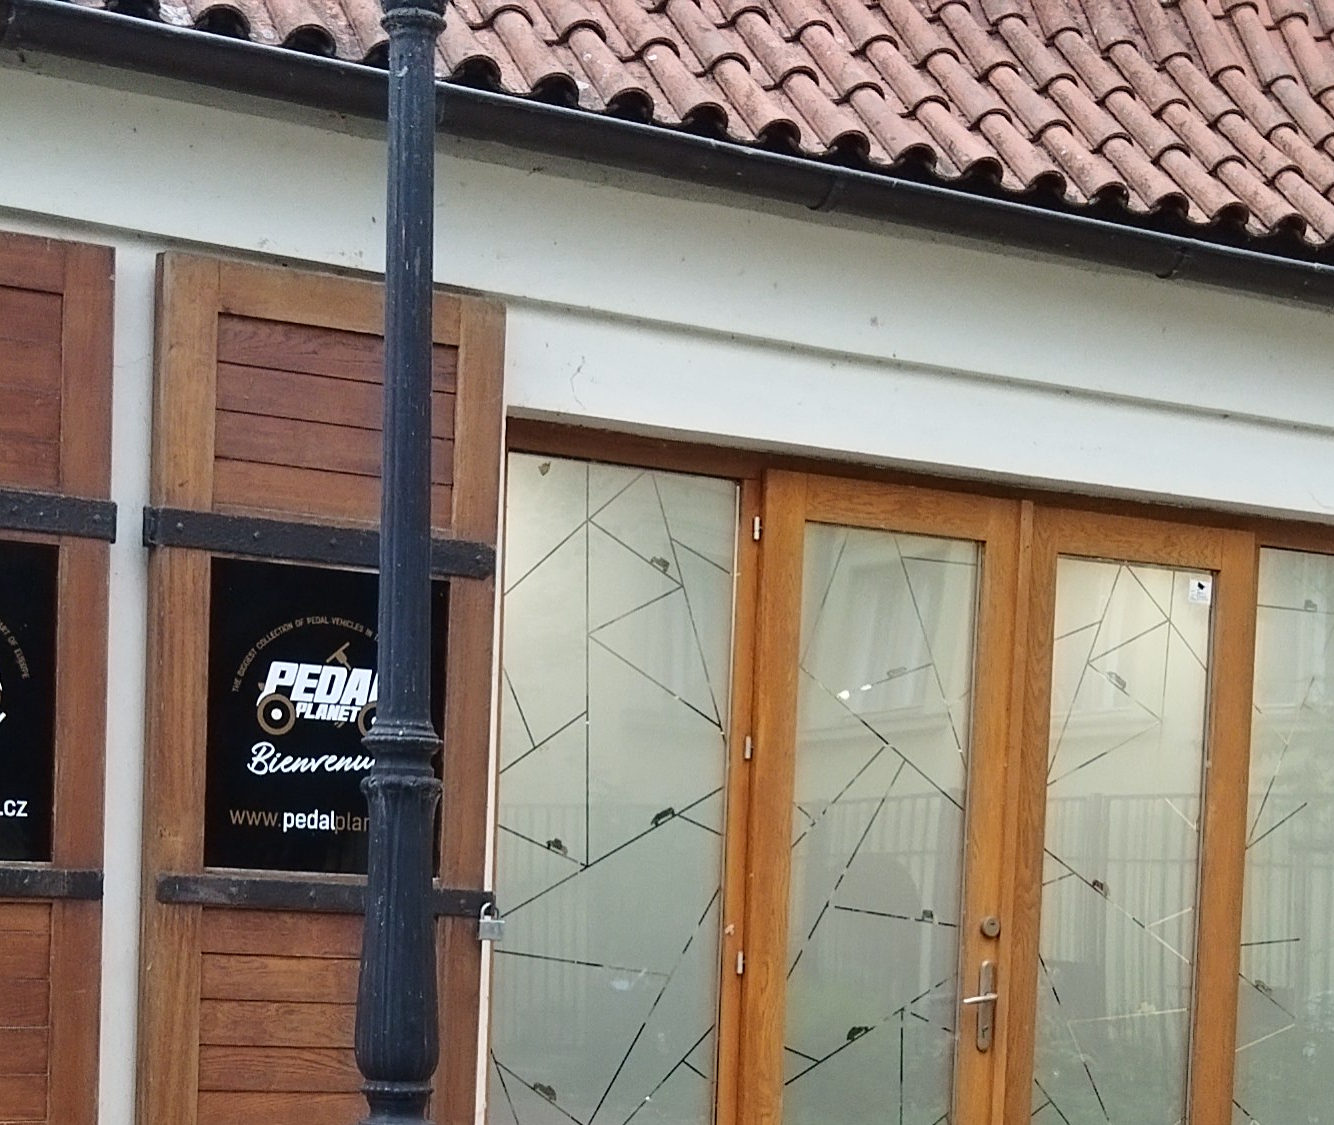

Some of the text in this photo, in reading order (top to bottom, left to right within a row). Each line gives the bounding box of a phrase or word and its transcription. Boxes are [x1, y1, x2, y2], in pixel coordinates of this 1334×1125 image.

[8, 636, 19, 647] OF
[231, 678, 242, 693] THE
[255, 623, 294, 650] COLLECTION
[295, 618, 305, 628] OF
[306, 615, 329, 625] PEDAL
[331, 616, 364, 633] VEHICLES
[295, 702, 362, 723] PLANET
[247, 741, 376, 775] Bienvenu
